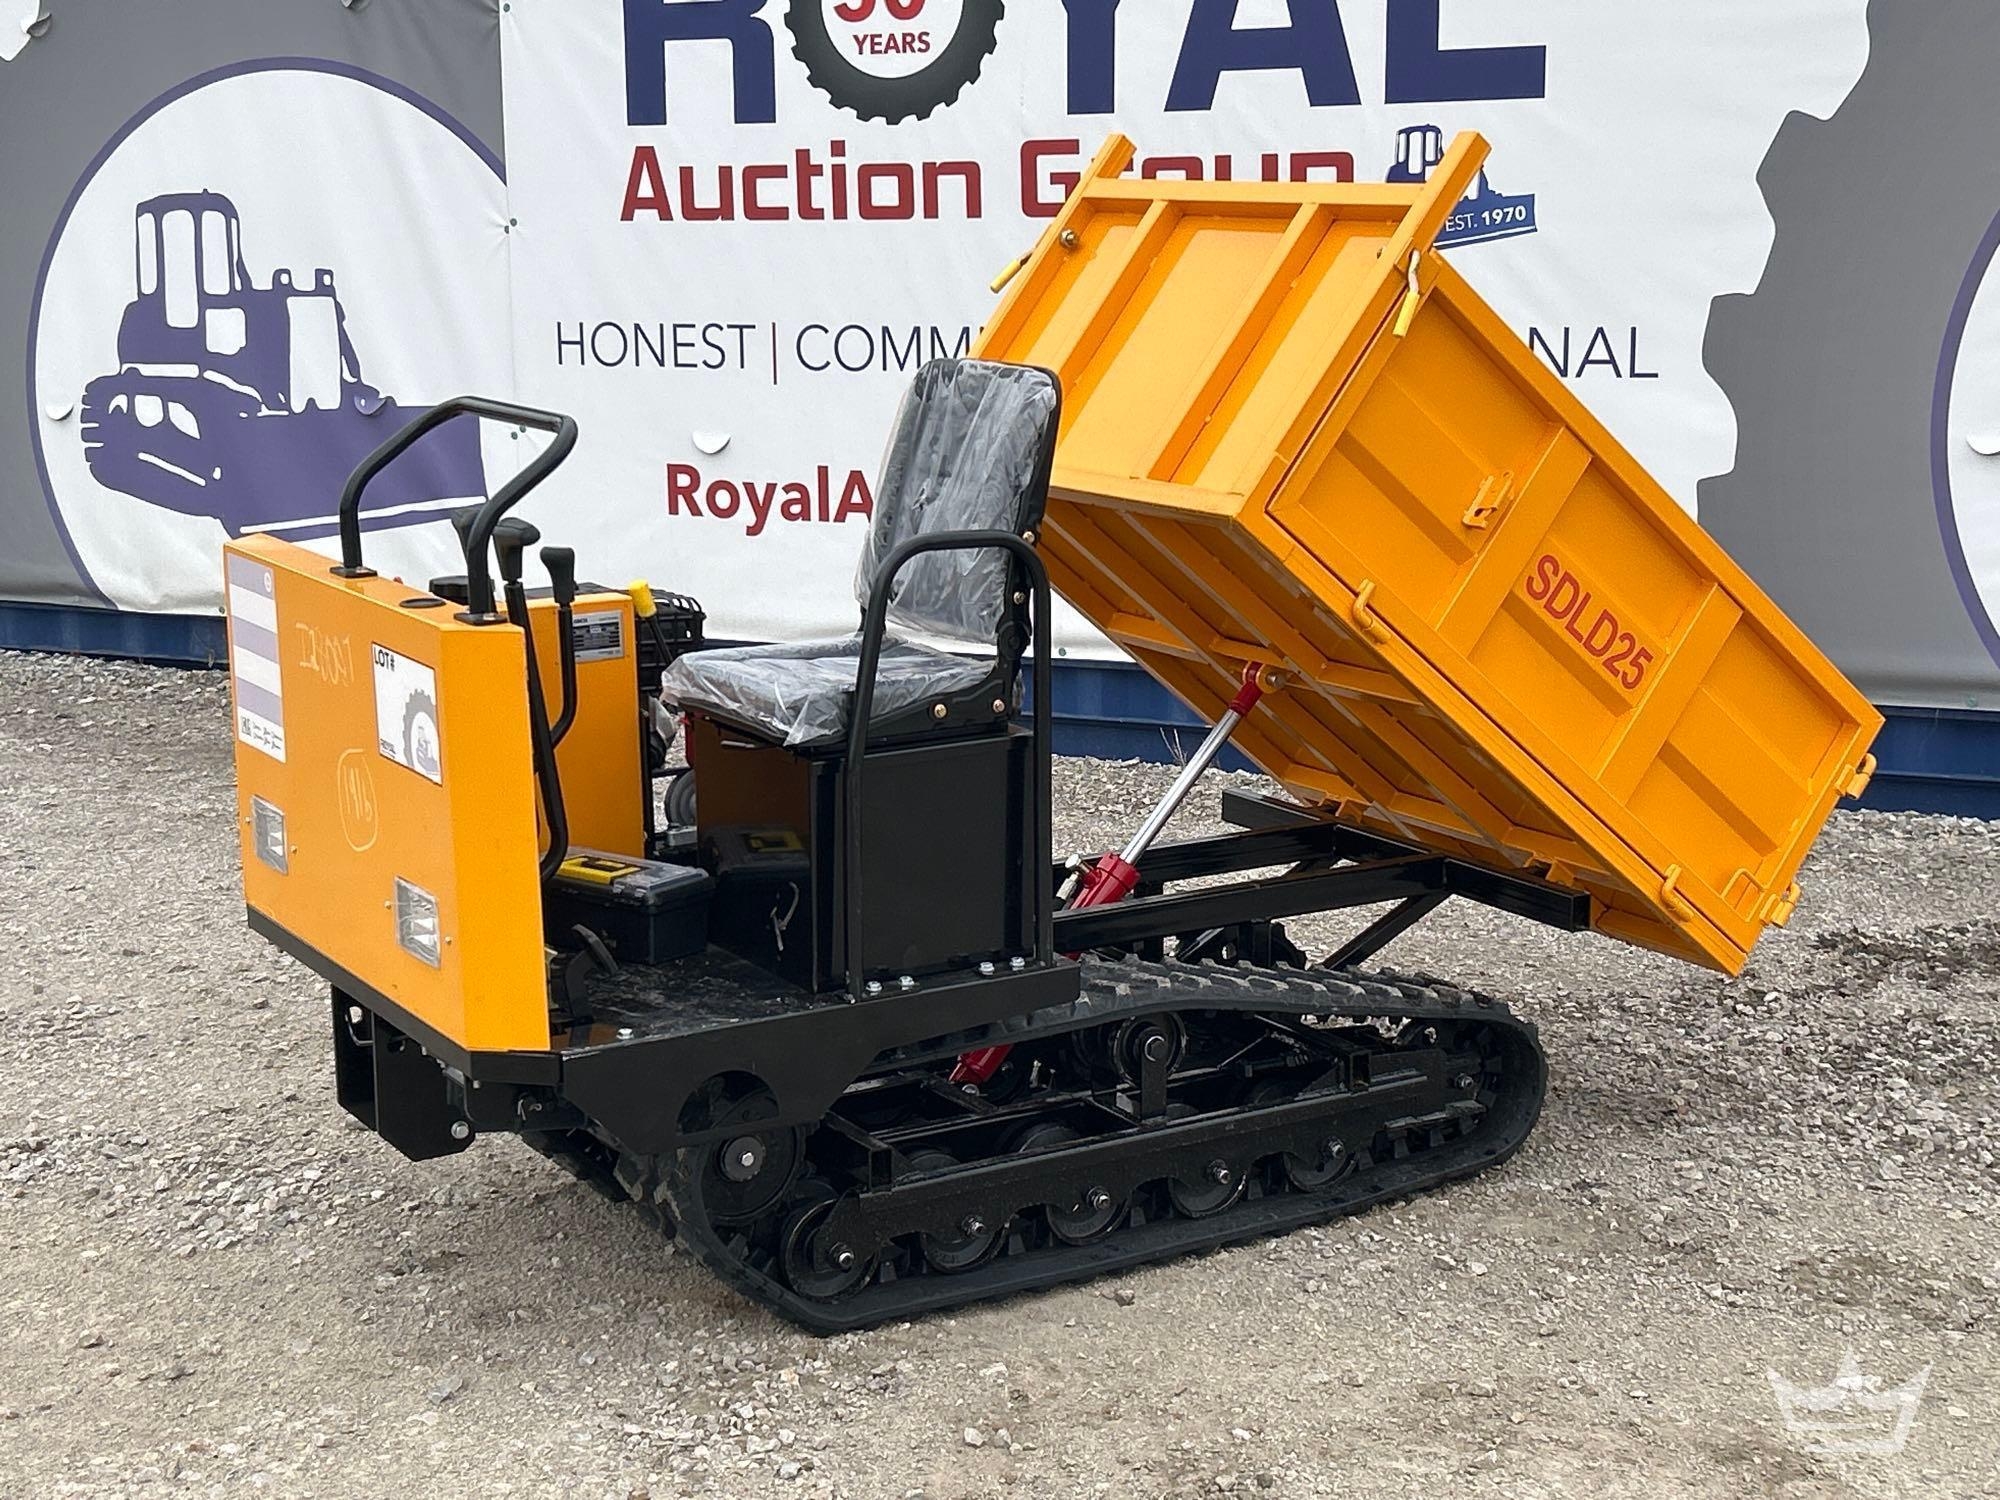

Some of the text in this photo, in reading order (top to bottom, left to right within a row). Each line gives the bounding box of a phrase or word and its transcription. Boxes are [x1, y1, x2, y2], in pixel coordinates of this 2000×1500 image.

[852, 31, 931, 55] YEARS
[620, 139, 983, 222] Auction
[1481, 205, 1527, 226] 1970
[556, 321, 757, 370] HONEST
[1526, 554, 1654, 690] SDLD25
